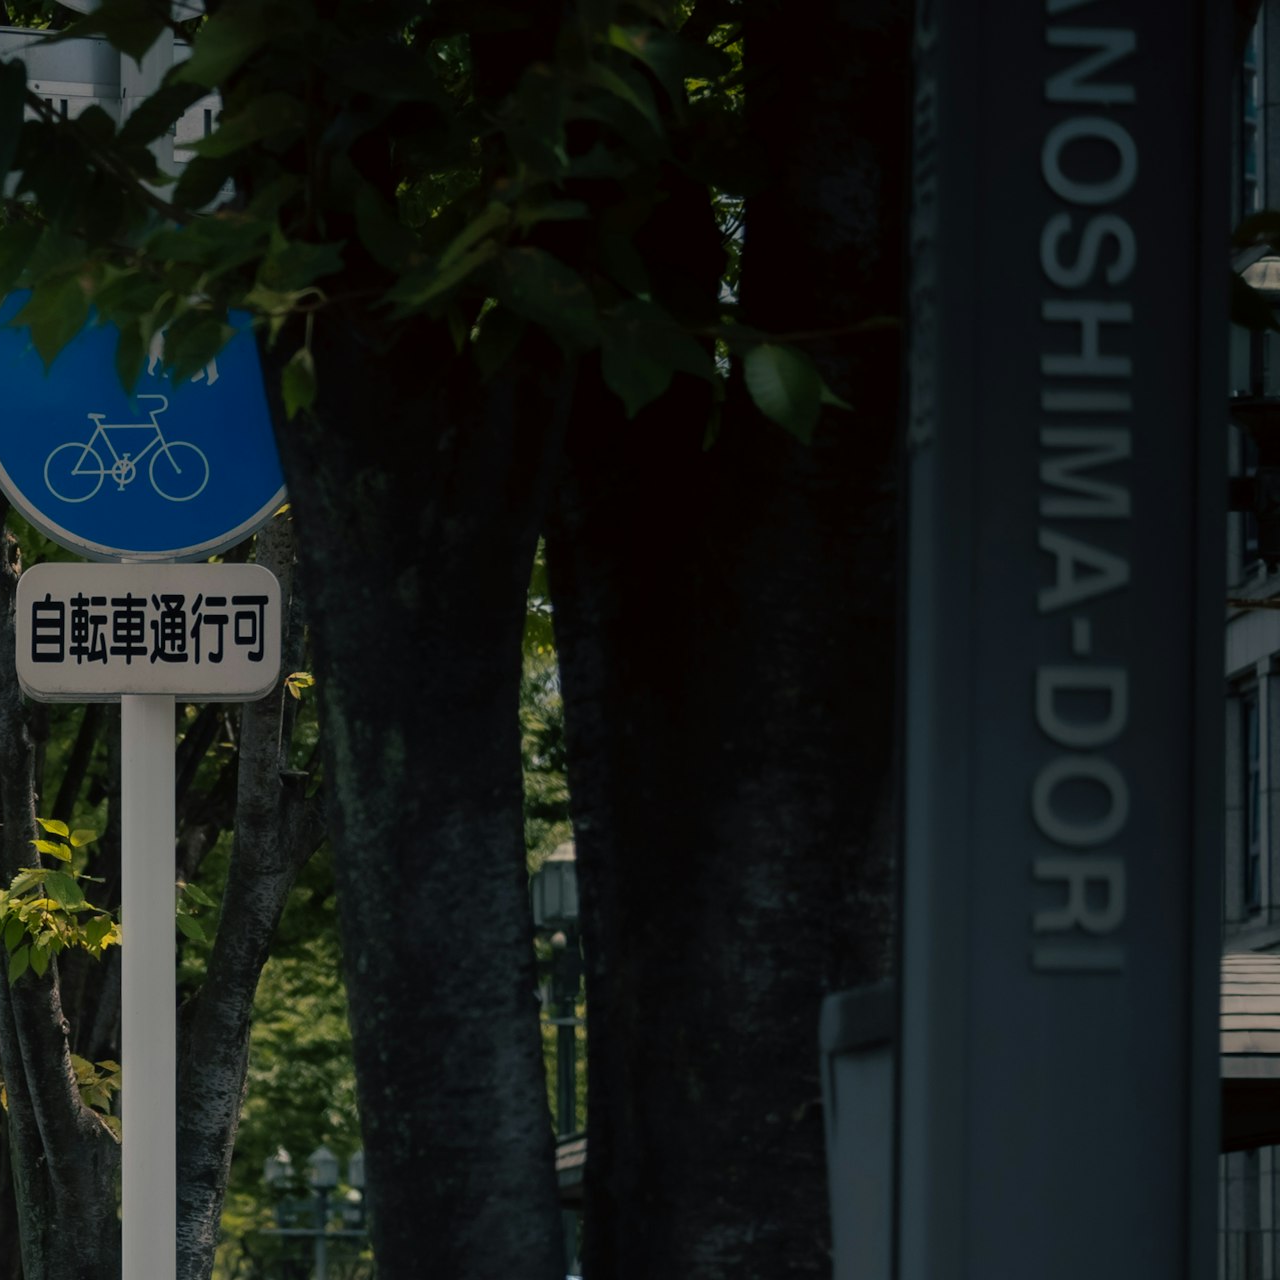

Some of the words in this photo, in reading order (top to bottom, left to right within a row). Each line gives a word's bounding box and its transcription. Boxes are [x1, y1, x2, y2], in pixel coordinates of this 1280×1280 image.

[31, 592, 269, 665] 自転車通行可
